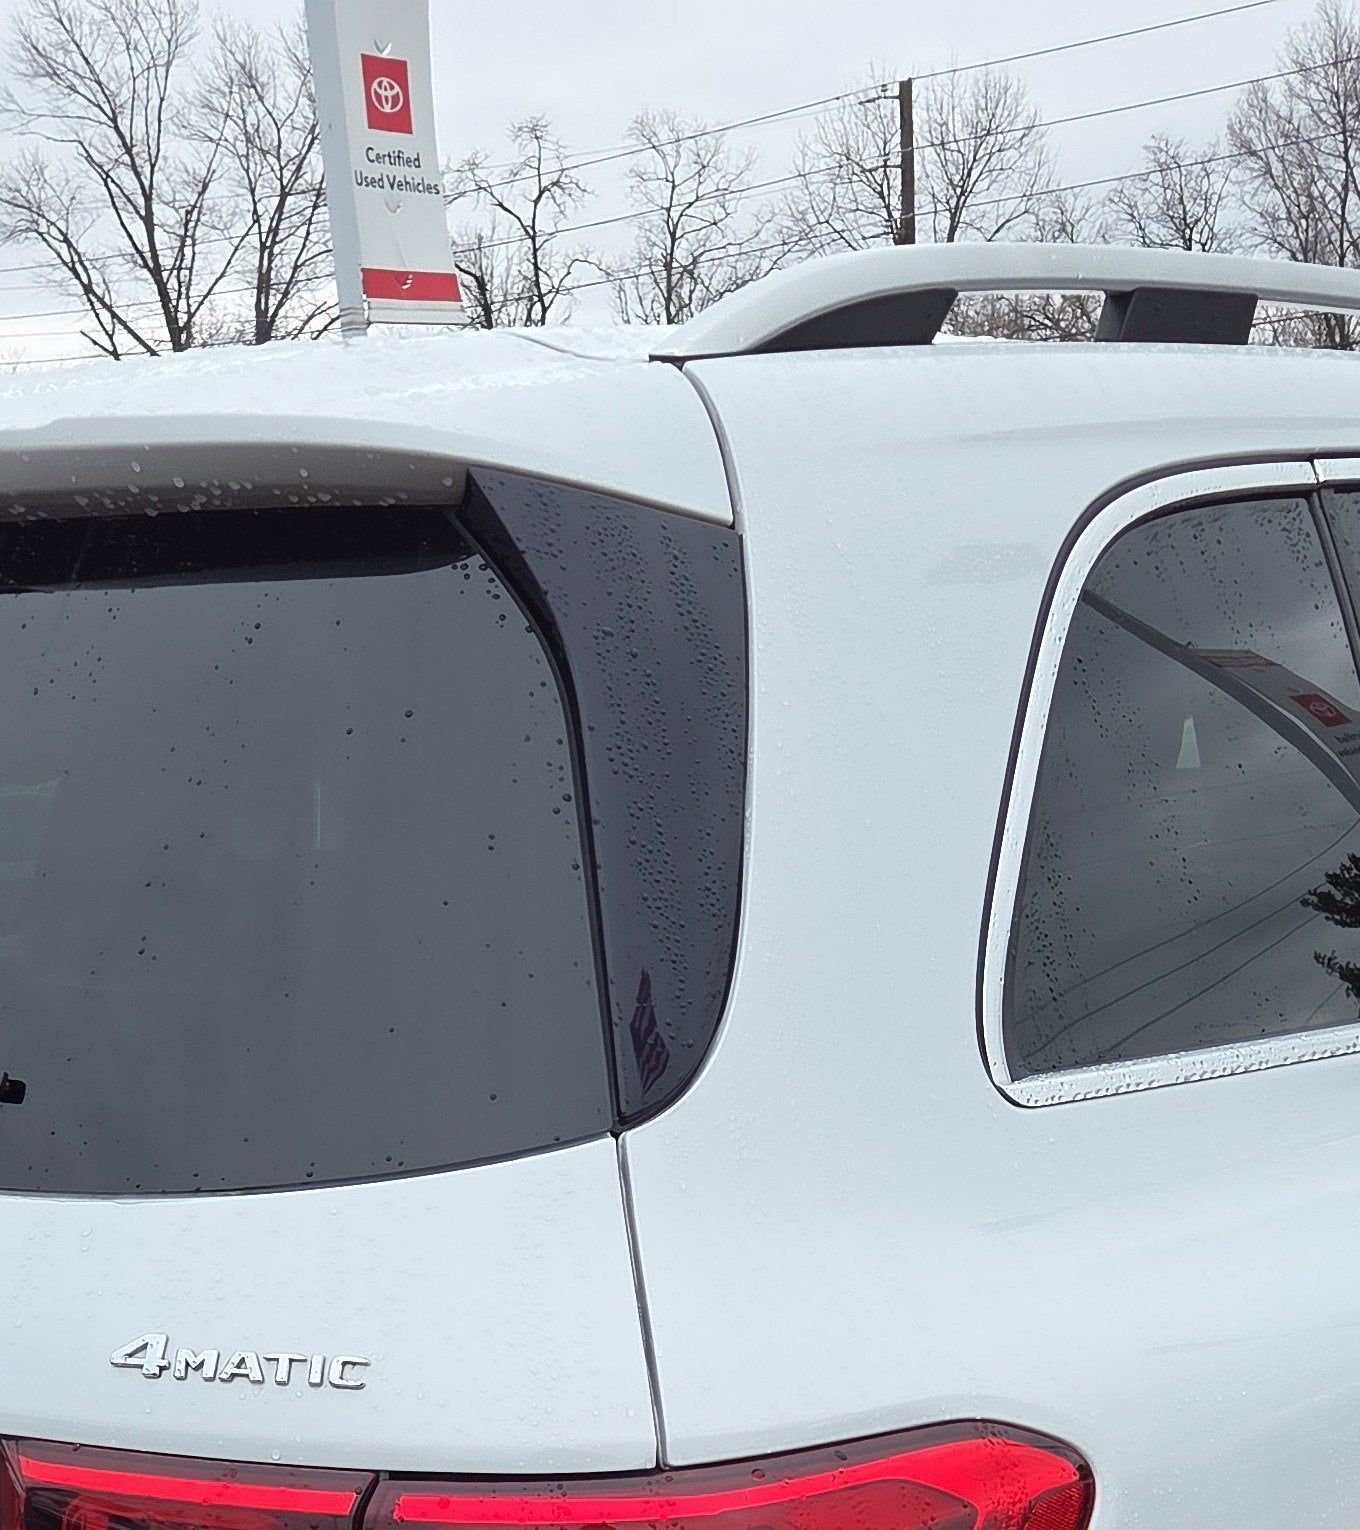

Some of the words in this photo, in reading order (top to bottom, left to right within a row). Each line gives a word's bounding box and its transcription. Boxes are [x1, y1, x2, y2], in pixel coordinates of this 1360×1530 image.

[365, 146, 421, 169] Certified
[354, 170, 385, 189] Used
[386, 174, 441, 195] Vehicles
[110, 1332, 371, 1390] 4MATIC
